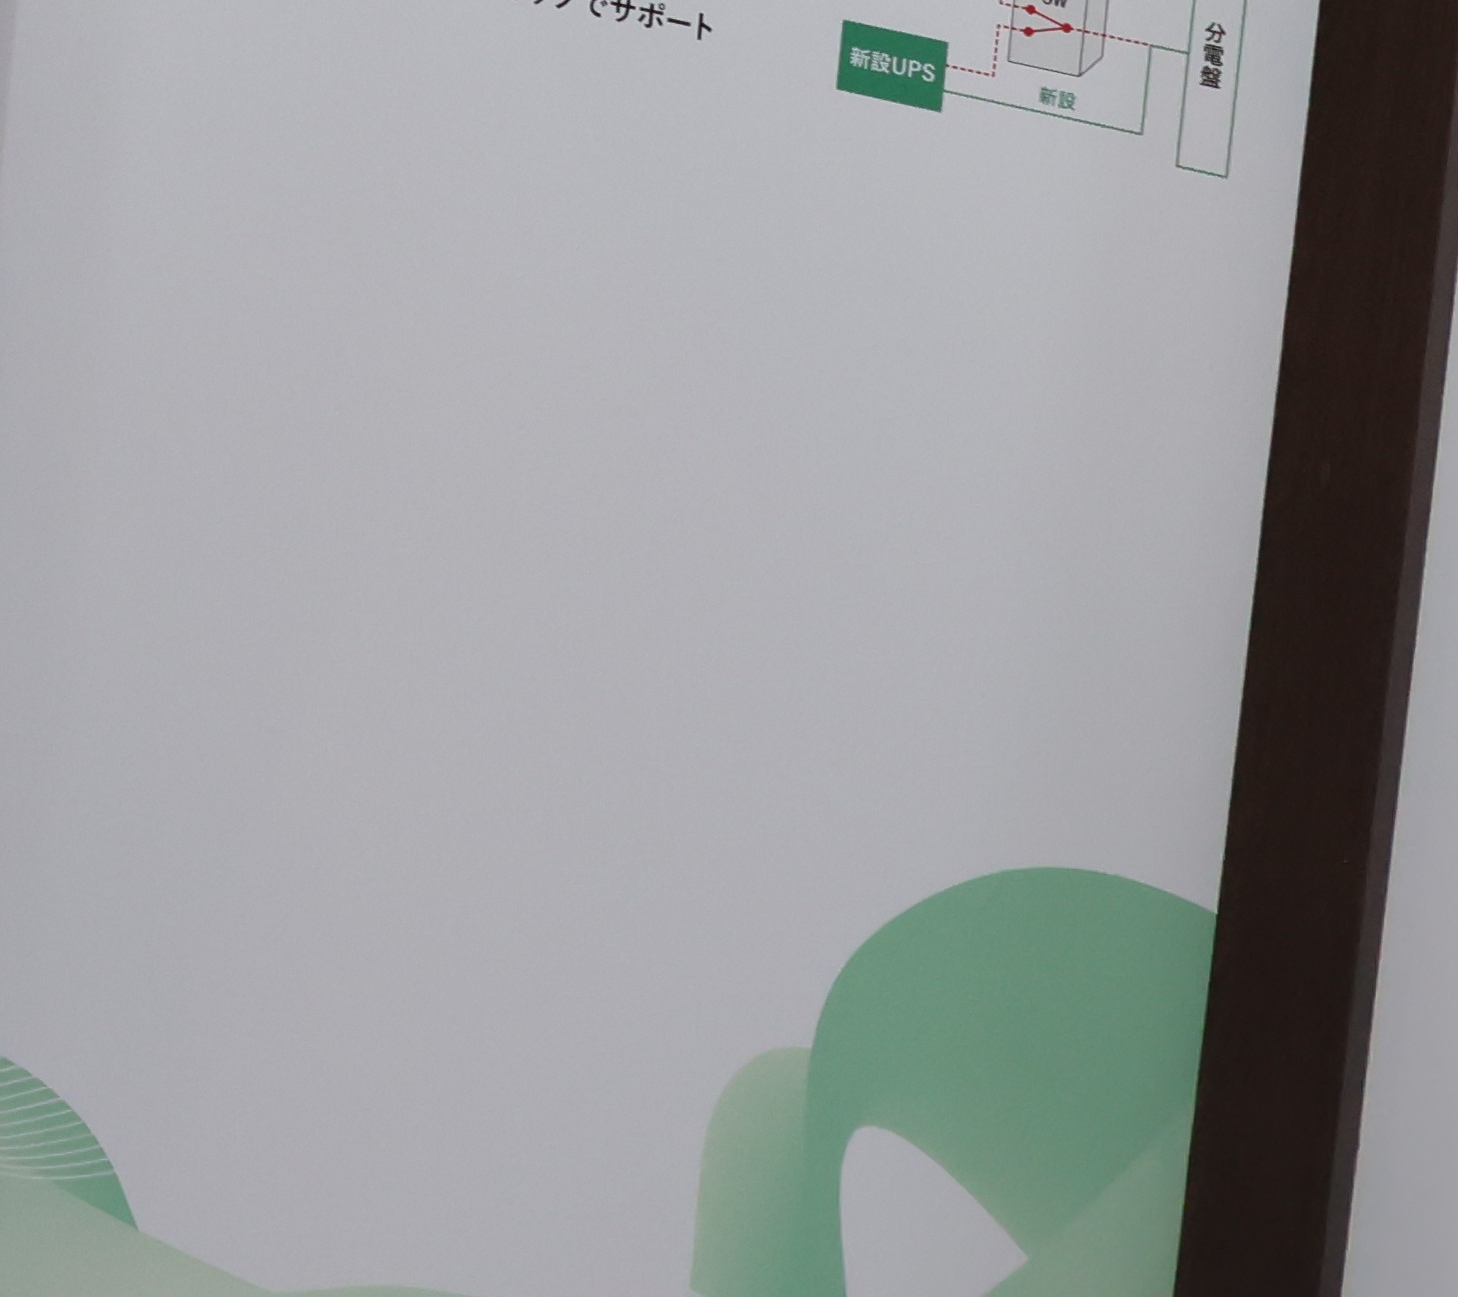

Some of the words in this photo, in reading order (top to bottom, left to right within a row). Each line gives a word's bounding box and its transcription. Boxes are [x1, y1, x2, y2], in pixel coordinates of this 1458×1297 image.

[848, 45, 937, 84] 新設UPS
[1197, 22, 1227, 91] 分電盤
[1038, 85, 1077, 112] 新設
